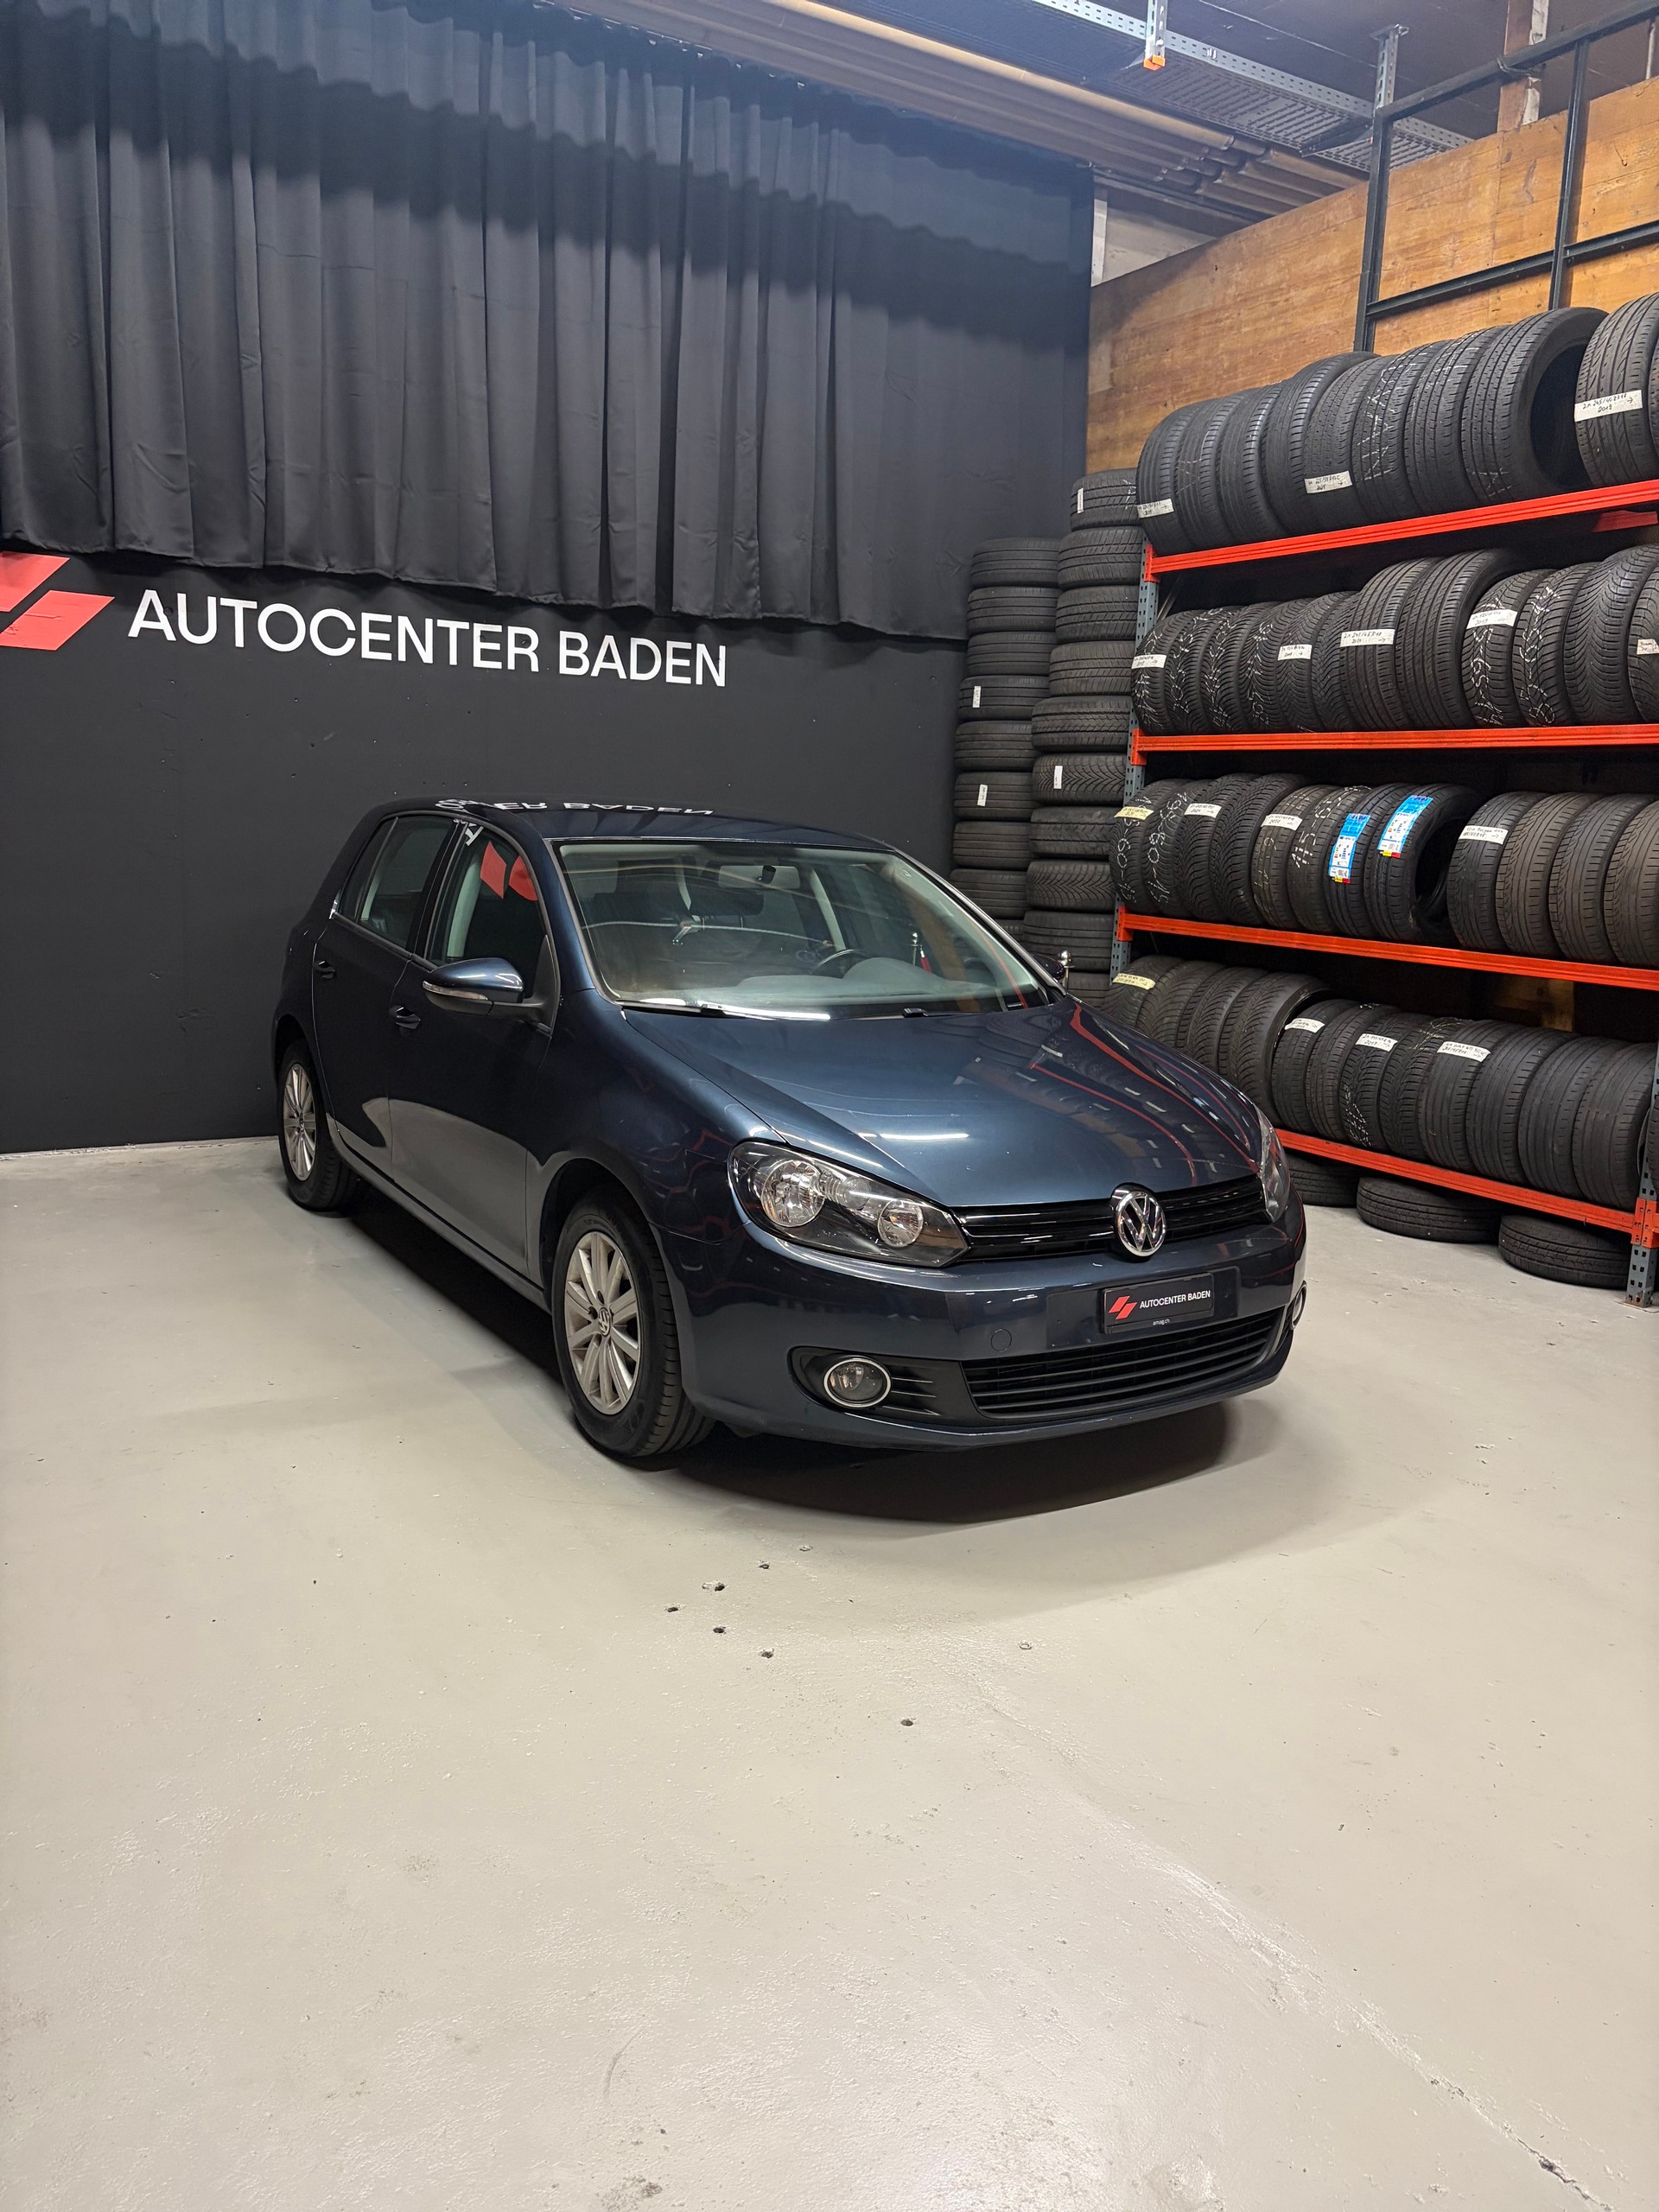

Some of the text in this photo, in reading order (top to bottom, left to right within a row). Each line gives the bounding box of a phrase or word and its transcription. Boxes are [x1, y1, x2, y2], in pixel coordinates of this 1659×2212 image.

[128, 589, 728, 688] AUTOCENTER BADEN
[1140, 1291, 1211, 1309] AUTOCENTER BADEN
